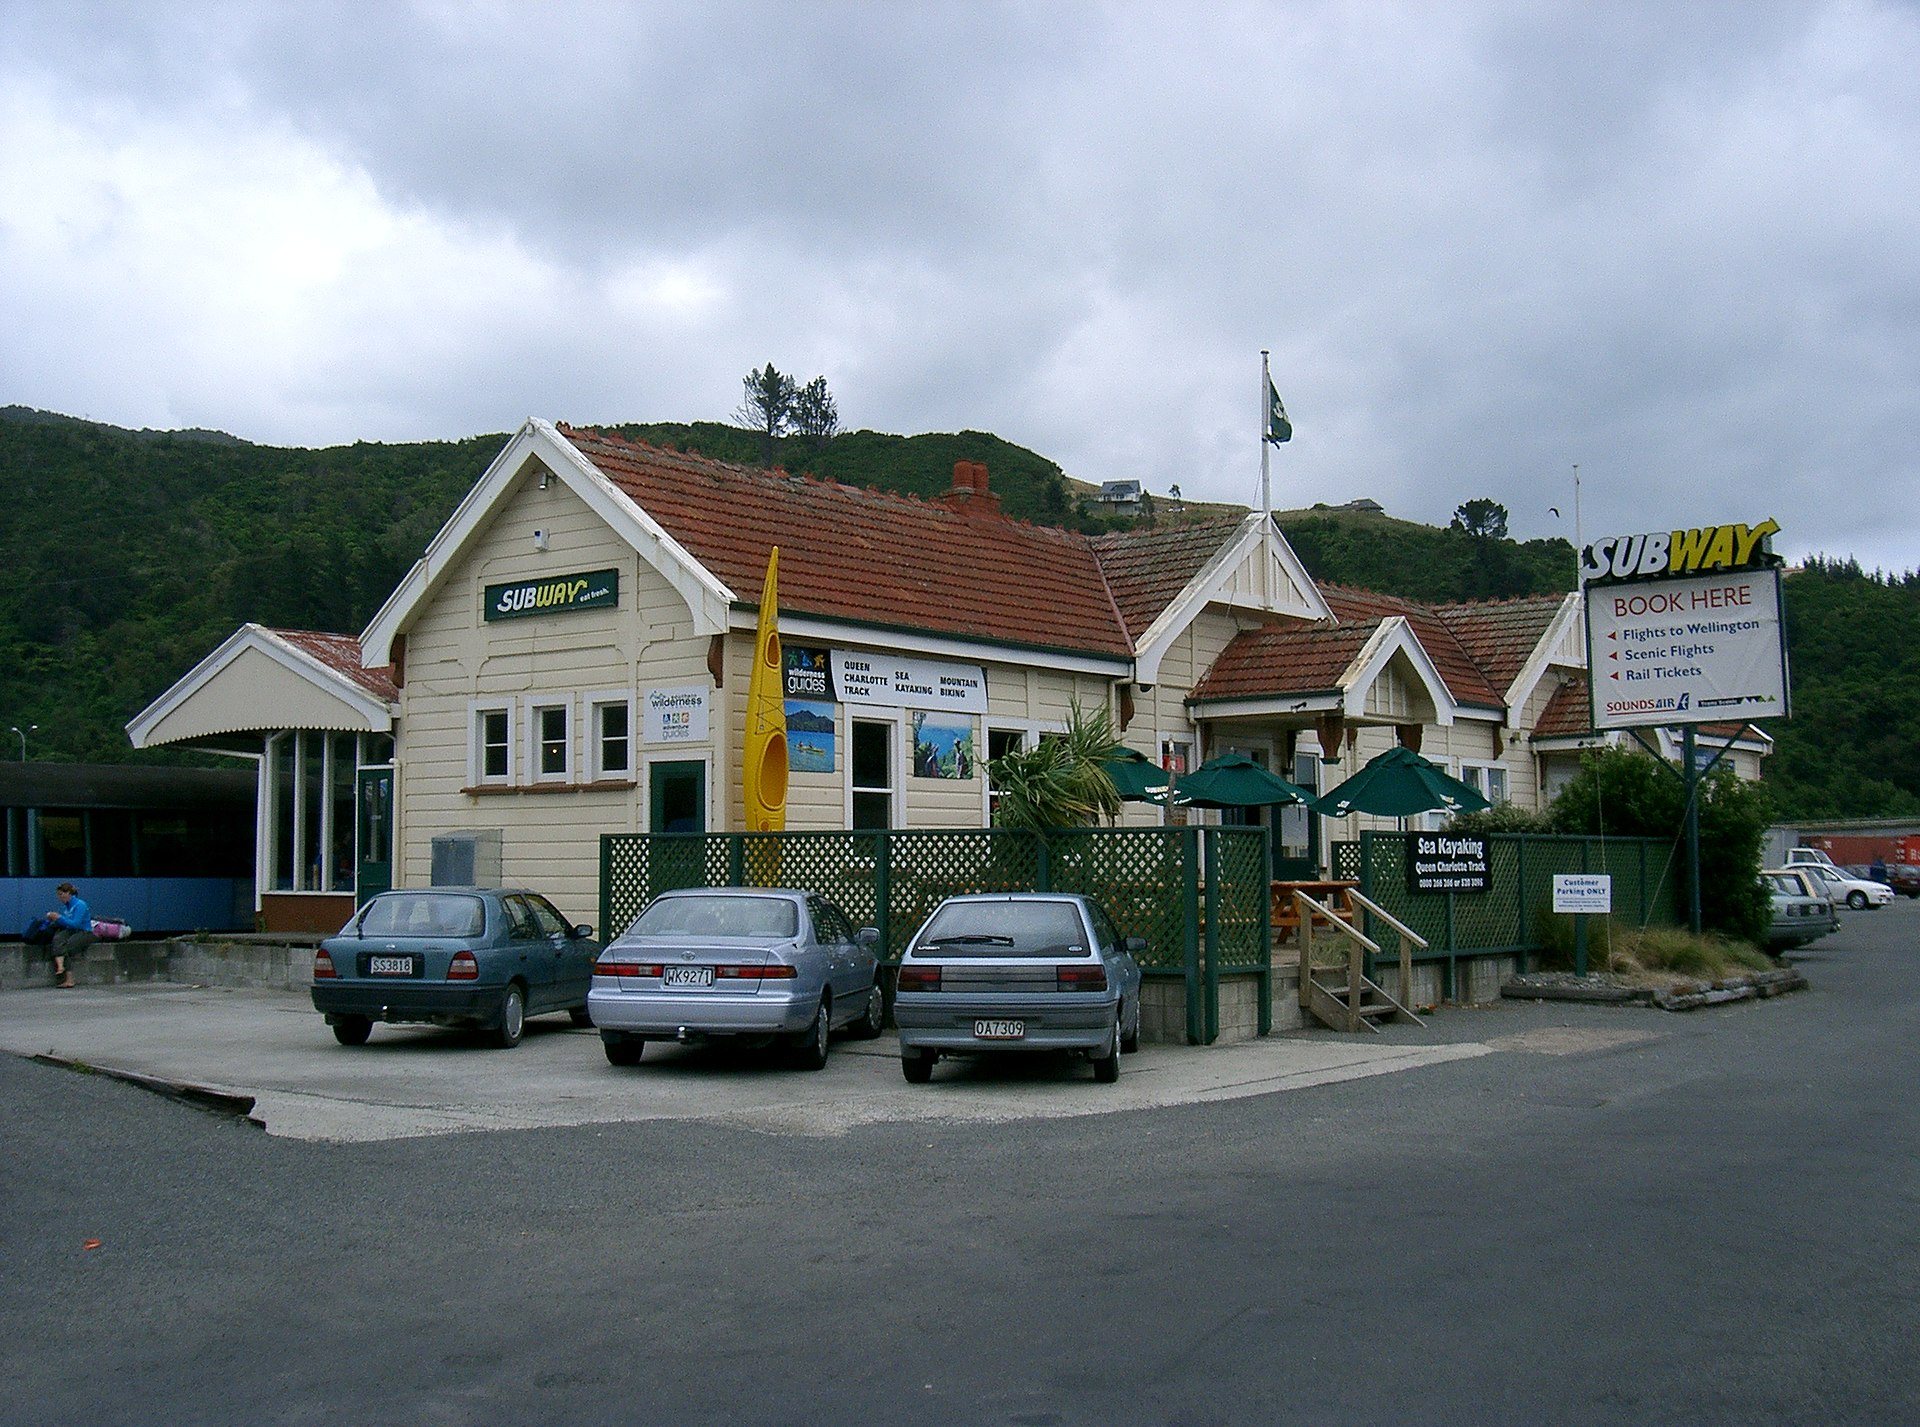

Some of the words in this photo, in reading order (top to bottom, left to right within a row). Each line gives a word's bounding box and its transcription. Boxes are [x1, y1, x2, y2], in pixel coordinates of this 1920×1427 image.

[1582, 517, 1781, 579] SUBWAY
[497, 580, 588, 612] SUBWAY
[580, 595, 591, 603] eat
[1614, 592, 1684, 617] BOOK
[1691, 585, 1751, 610] HERE
[1623, 628, 1666, 642] Flights
[1670, 627, 1684, 636] to
[1687, 620, 1760, 635] Wellington
[1625, 647, 1667, 661] Scenic
[1670, 644, 1715, 658] Flights
[844, 660, 870, 672] QUEEN
[844, 673, 888, 686] CHARLOTTE
[895, 671, 910, 681] SEA
[1626, 668, 1650, 681] Rail
[1654, 666, 1702, 679] Tickets
[788, 676, 826, 693] guides
[940, 676, 978, 688] MOUNTAIN
[844, 685, 870, 696] TRACK
[895, 684, 933, 695] KAYAKING
[940, 688, 966, 698] BIKING
[651, 697, 702, 707] wilderness
[1418, 837, 1436, 855] Sea
[1438, 837, 1483, 859] Kayaking
[1415, 861, 1436, 875] Queen
[1437, 861, 1467, 873] Charlotte
[1468, 861, 1486, 872] Track
[1557, 888, 1585, 896] Parking
[372, 960, 411, 972] SS3818
[667, 968, 711, 984] WK9271
